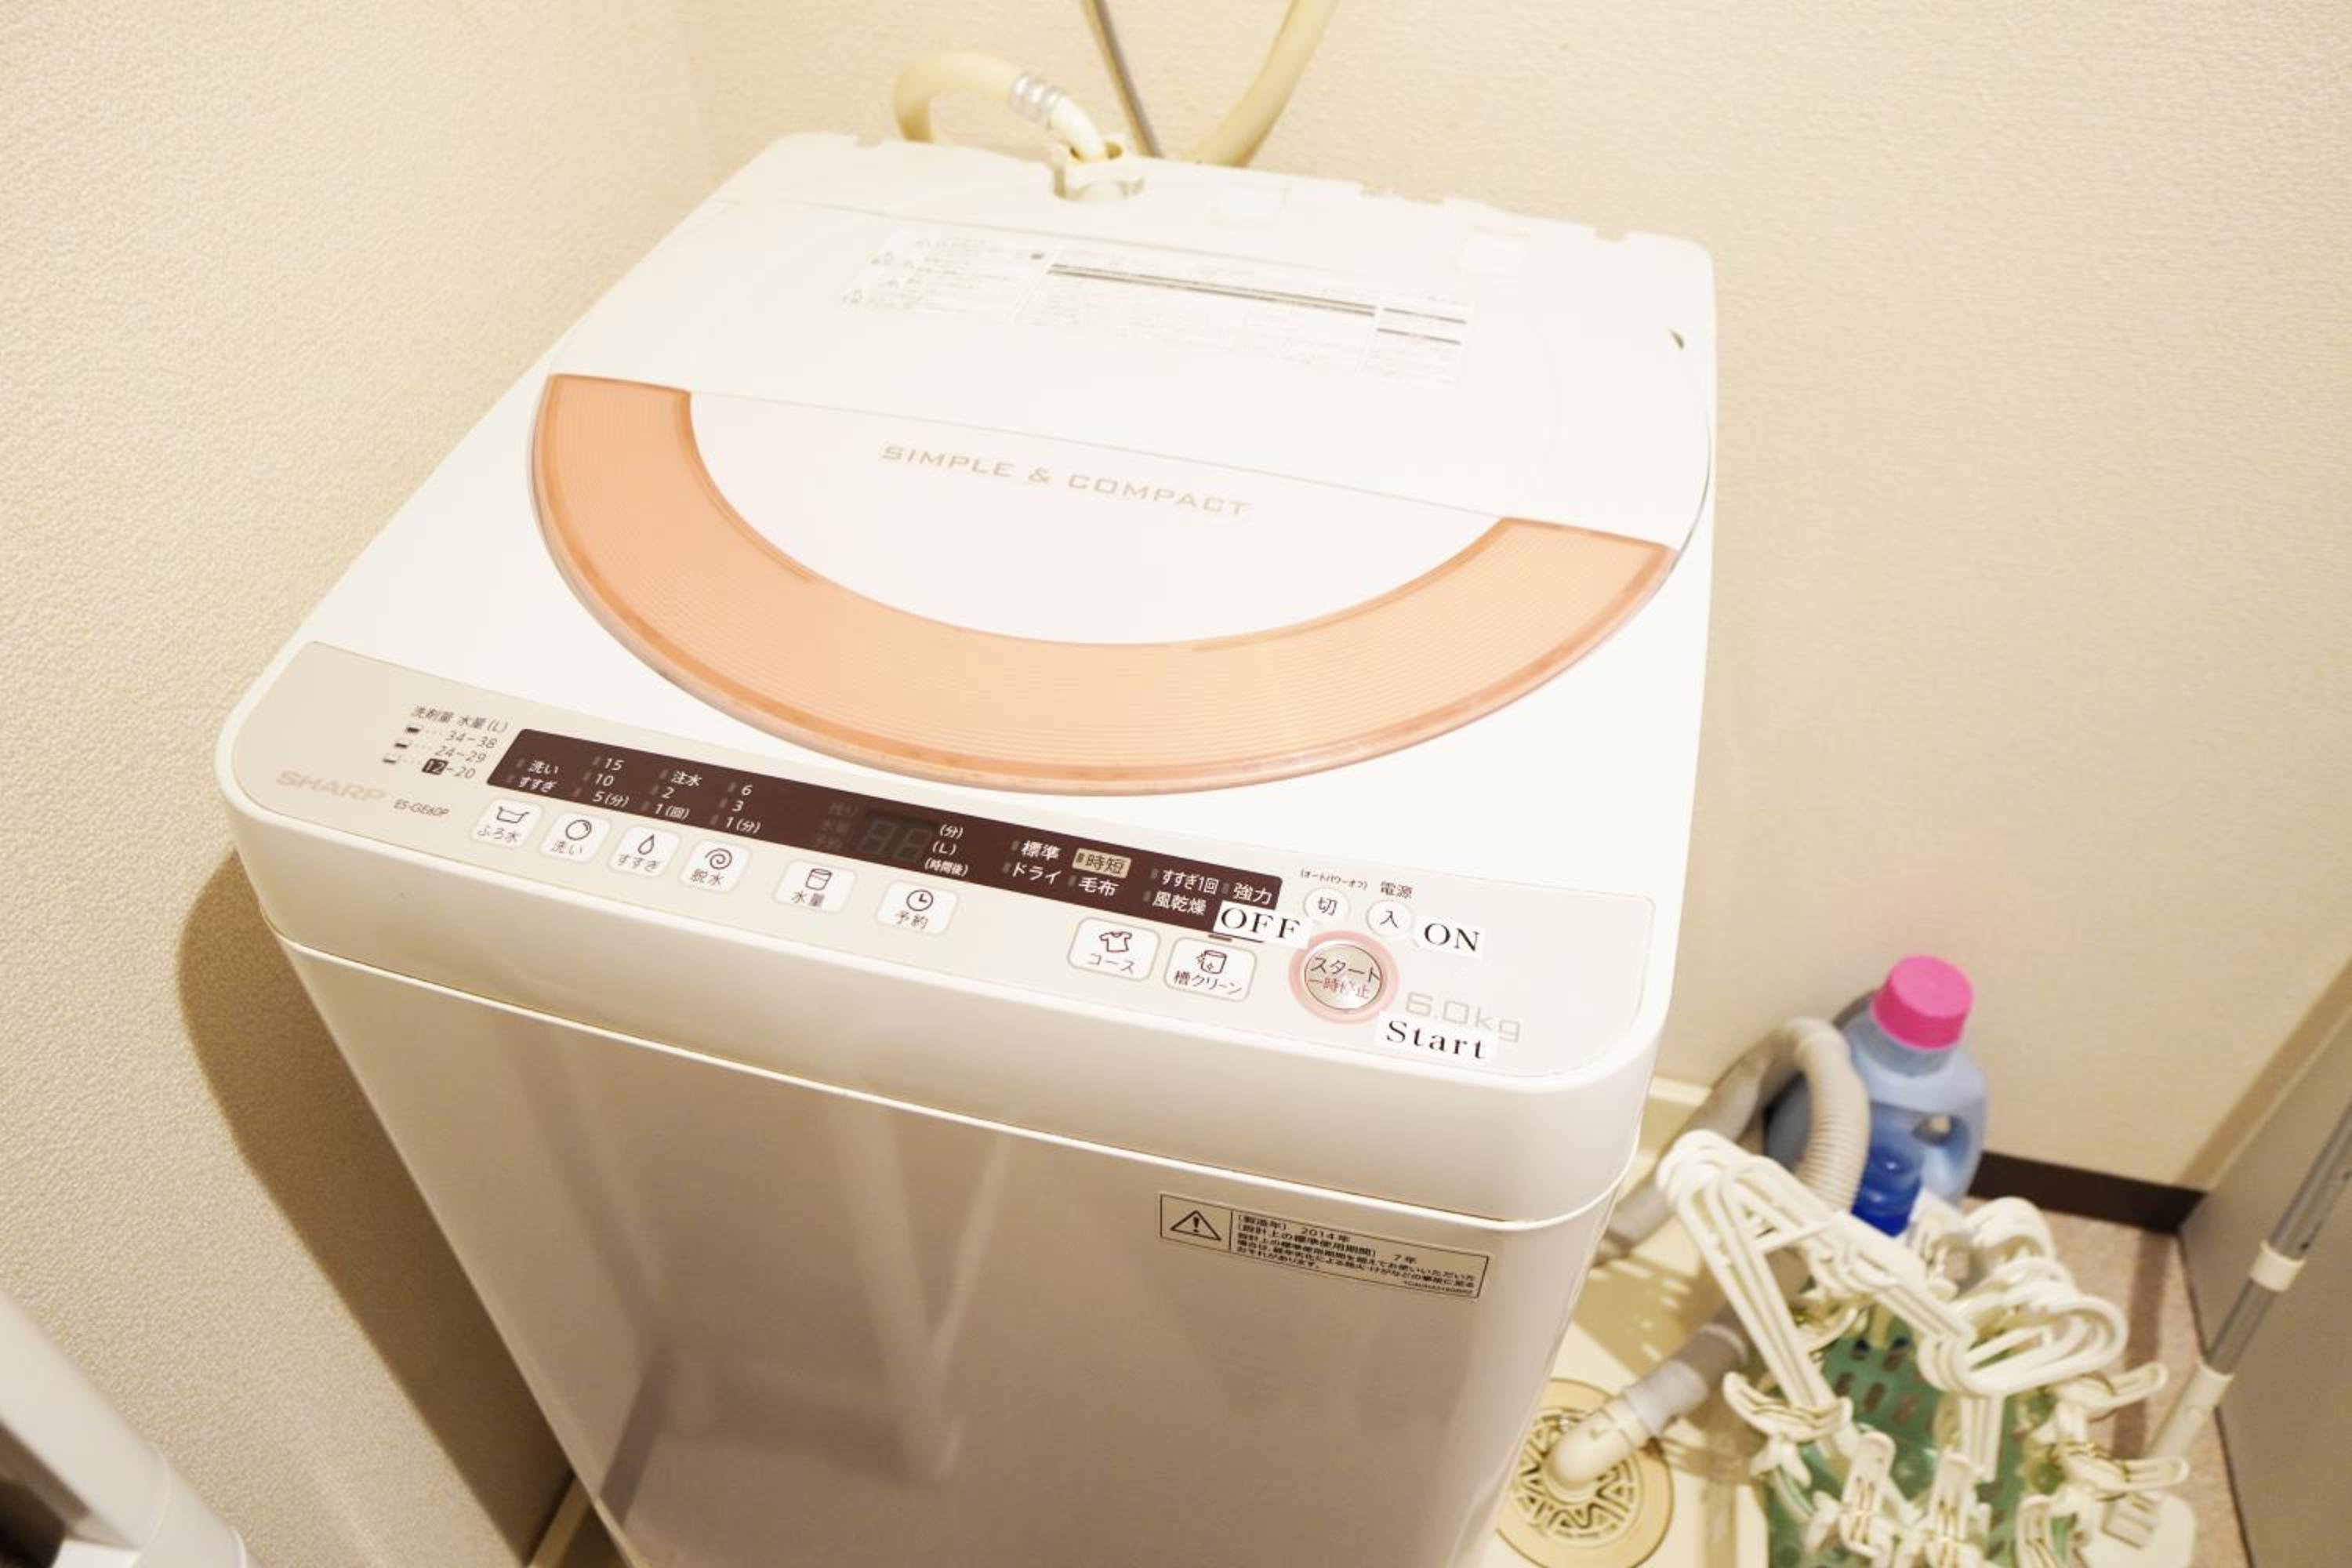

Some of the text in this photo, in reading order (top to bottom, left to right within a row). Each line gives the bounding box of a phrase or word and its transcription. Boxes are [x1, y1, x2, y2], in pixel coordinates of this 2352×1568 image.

[881, 445, 1252, 516] SIMPLE & COMPACT
[412, 706, 455, 723] 洗剤量
[528, 760, 559, 774] 洗い
[604, 757, 625, 771] 15
[276, 770, 387, 801] SHARP
[519, 776, 557, 793] すすぎ
[595, 774, 614, 786] 10
[670, 771, 702, 786] 注水
[662, 786, 675, 799] 2
[741, 785, 753, 796] 6
[731, 800, 744, 811] 3
[477, 825, 521, 844] ふろ水
[940, 824, 964, 839] (分)
[550, 840, 583, 856] 洗い
[932, 840, 957, 855] (L)
[1021, 840, 1061, 861] 標準
[618, 853, 662, 873] すすぎ
[924, 857, 968, 877] (時間後)
[1085, 854, 1127, 874] 時短
[690, 868, 726, 886] 脱水
[1012, 862, 1062, 884] ドライ
[1161, 869, 1218, 895] すすぎ1回
[1078, 877, 1120, 896] 毛布
[1233, 882, 1272, 906] 強力
[1380, 880, 1414, 900] 電源
[791, 890, 825, 908] 水量
[1152, 891, 1207, 916] 風乾燥
[1317, 896, 1338, 916] 切
[895, 910, 929, 929] 予約
[1221, 907, 1301, 939] OFF
[1379, 910, 1399, 929] 入
[1424, 923, 1481, 952] ON
[1087, 953, 1135, 975] コース
[1310, 956, 1381, 983] スタート
[1173, 970, 1243, 995] 槽クリーン
[1386, 1019, 1486, 1059] Start
